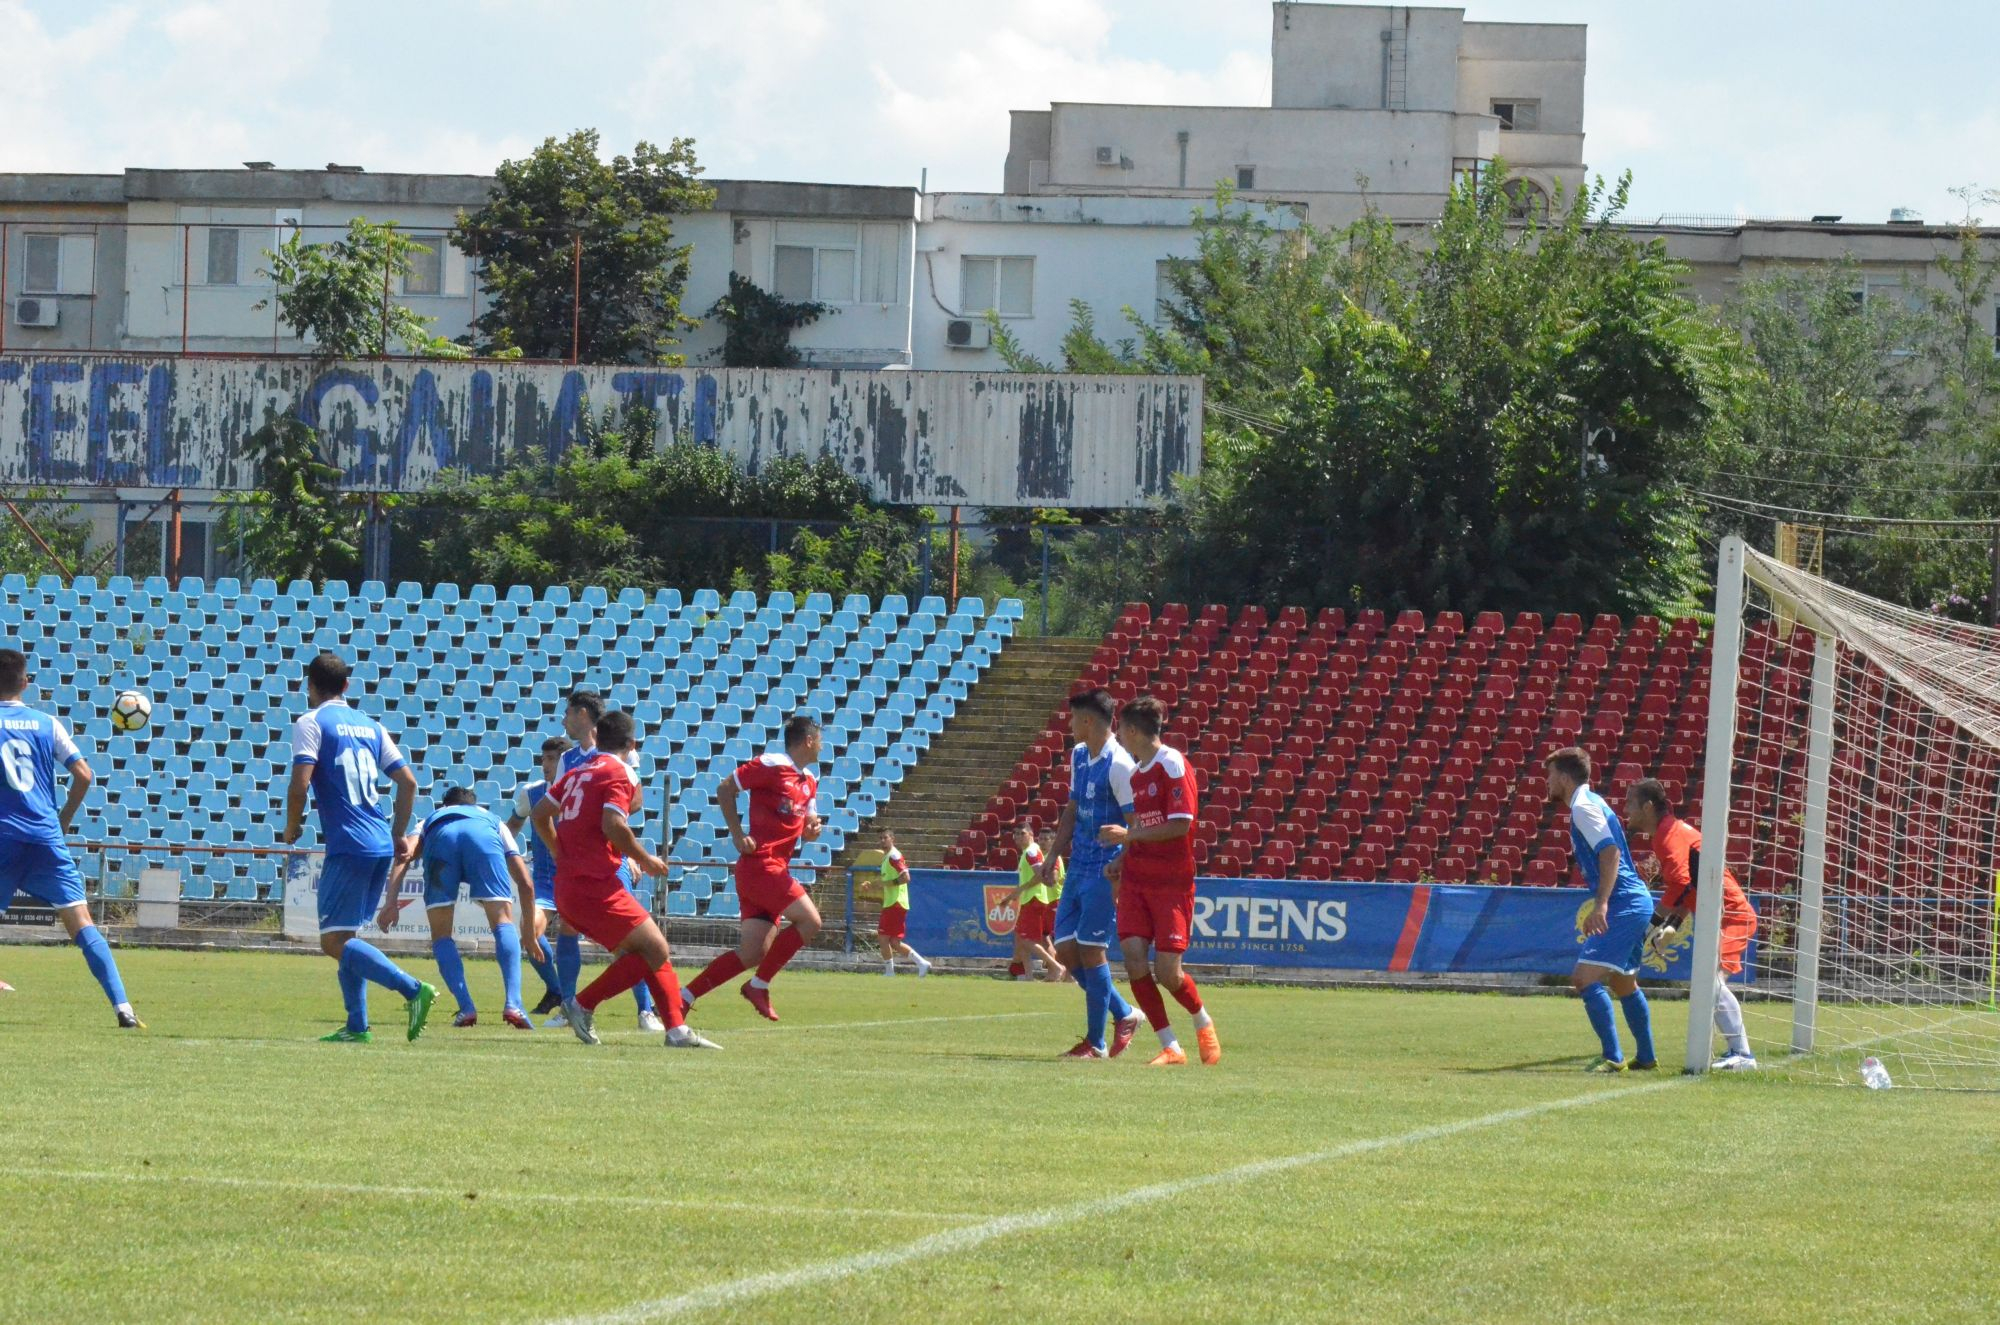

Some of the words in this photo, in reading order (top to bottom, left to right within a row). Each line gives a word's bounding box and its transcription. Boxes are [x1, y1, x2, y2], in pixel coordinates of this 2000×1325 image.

[1, 739, 35, 793] 6
[335, 747, 379, 807] 10
[558, 772, 593, 822] 25
[1190, 896, 1348, 942] RTENS
[1187, 941, 1236, 950] REWERS
[1240, 942, 1275, 952] SINCE
